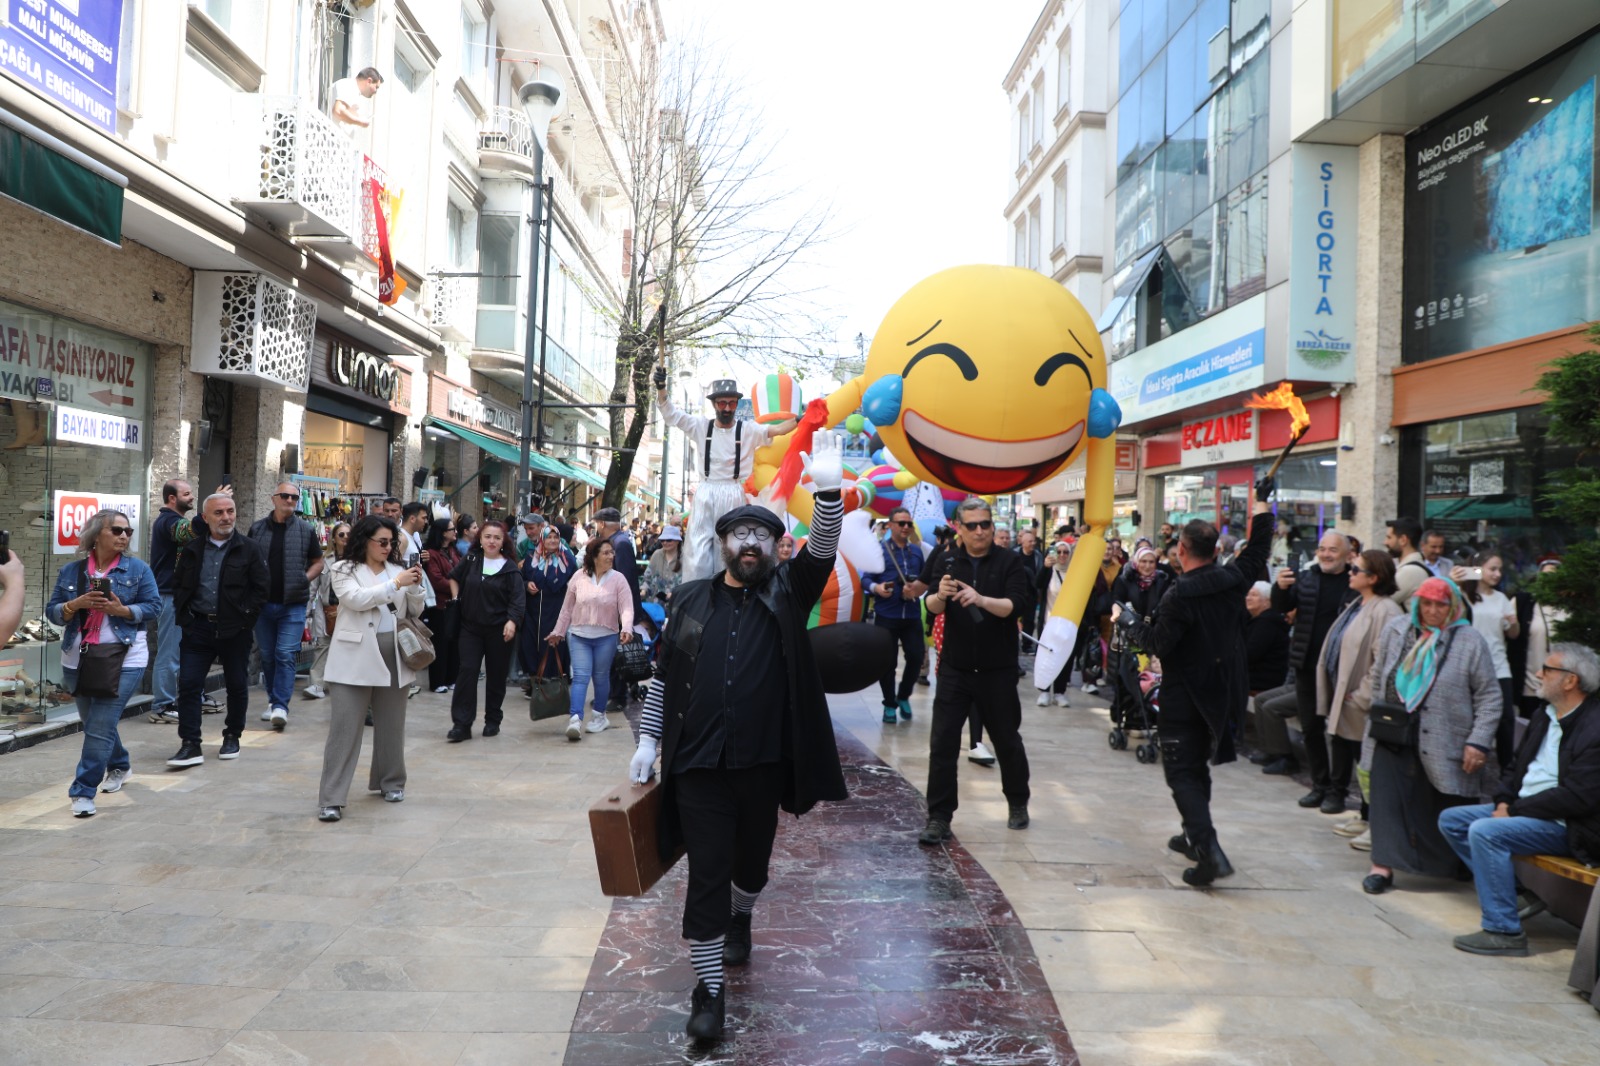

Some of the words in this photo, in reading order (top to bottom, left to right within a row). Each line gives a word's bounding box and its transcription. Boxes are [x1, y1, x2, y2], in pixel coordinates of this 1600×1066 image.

[18, 7, 47, 39] MALİ
[49, 28, 95, 73] MÜŞAVİR
[50, 6, 113, 65] MUHASEBECİ
[0, 38, 43, 83] ÇAĞLA
[45, 68, 112, 126] ENGİNYURT
[1417, 144, 1441, 166] Neo
[1442, 126, 1472, 152] QLED
[1473, 115, 1489, 137] 8K
[1315, 161, 1335, 316] SİGORTA
[36, 333, 135, 388] TAŞINIYORUZ
[1210, 341, 1253, 372] Hizmetleri
[62, 413, 97, 439] BAYAN
[101, 420, 139, 445] BOTLAR
[1182, 409, 1253, 451] ECZANE
